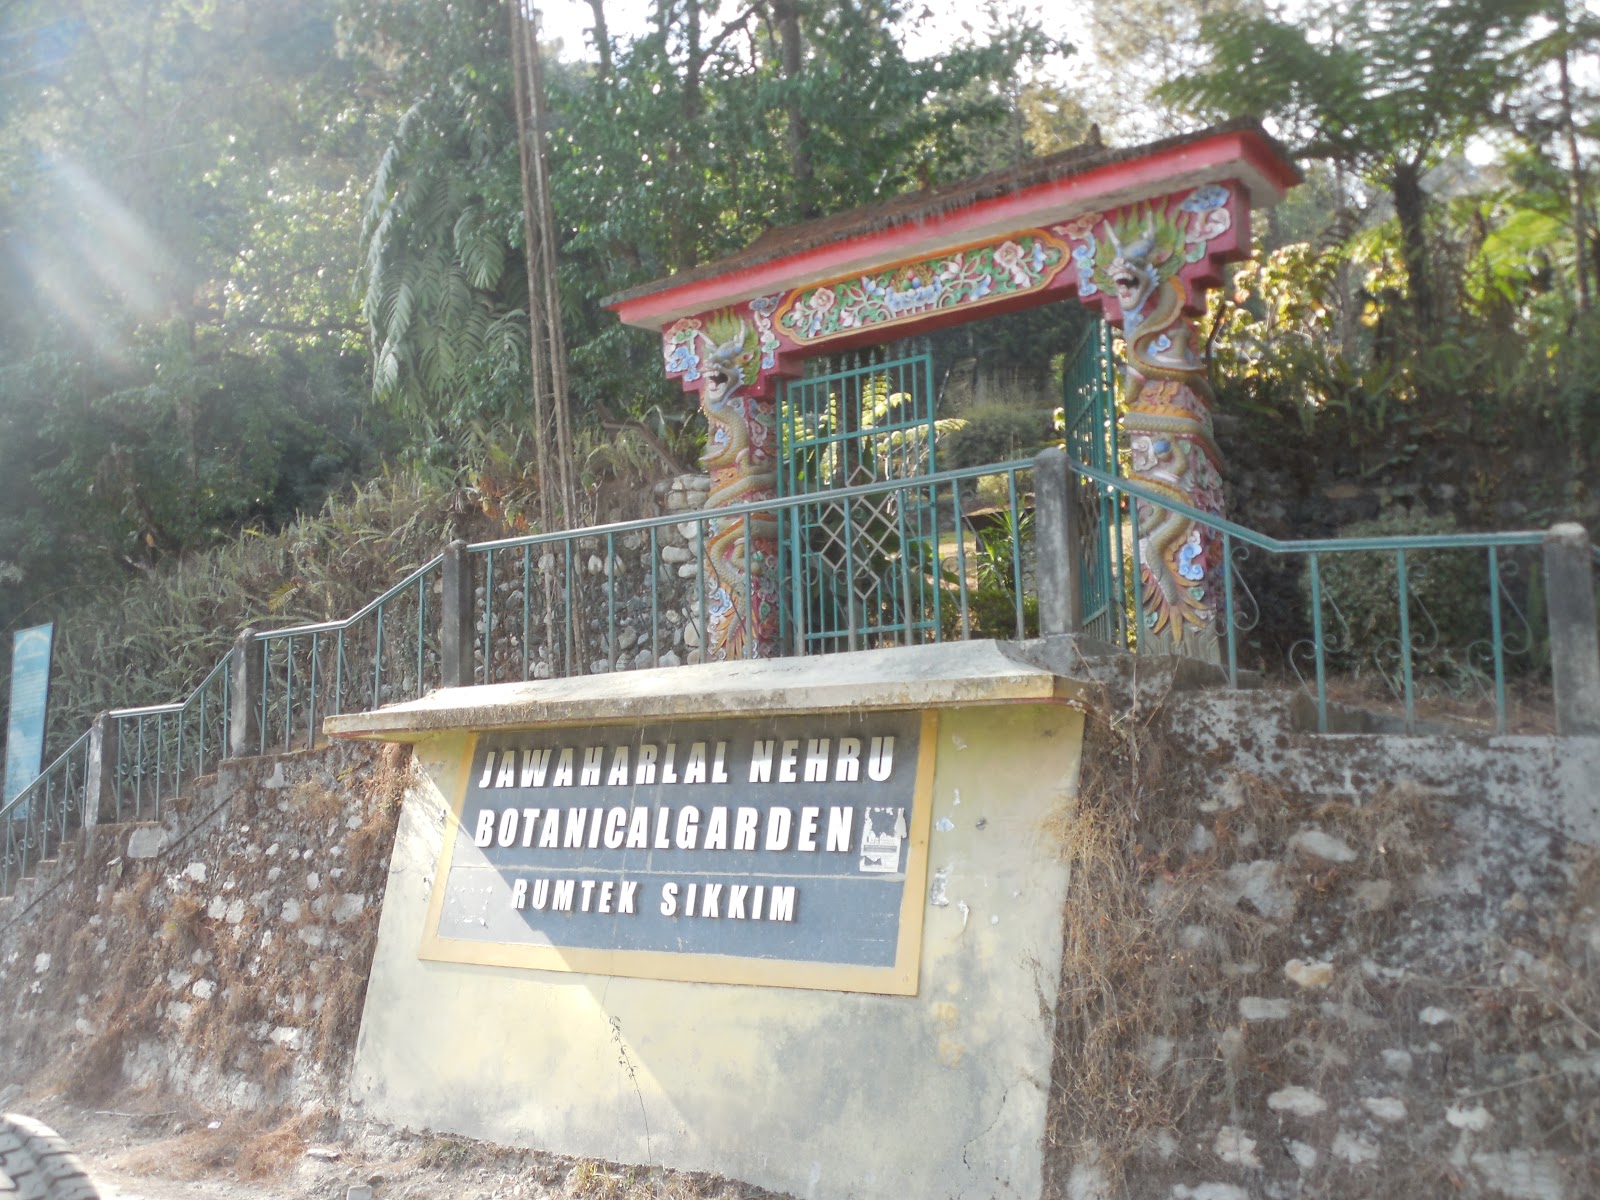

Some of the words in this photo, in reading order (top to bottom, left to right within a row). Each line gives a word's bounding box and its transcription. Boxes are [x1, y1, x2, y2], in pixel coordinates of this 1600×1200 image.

[479, 741, 729, 788] JAWAHARLAL
[749, 736, 895, 783] NEHRU
[512, 879, 637, 914] RUMTEK
[661, 882, 795, 922] SIKKIM
